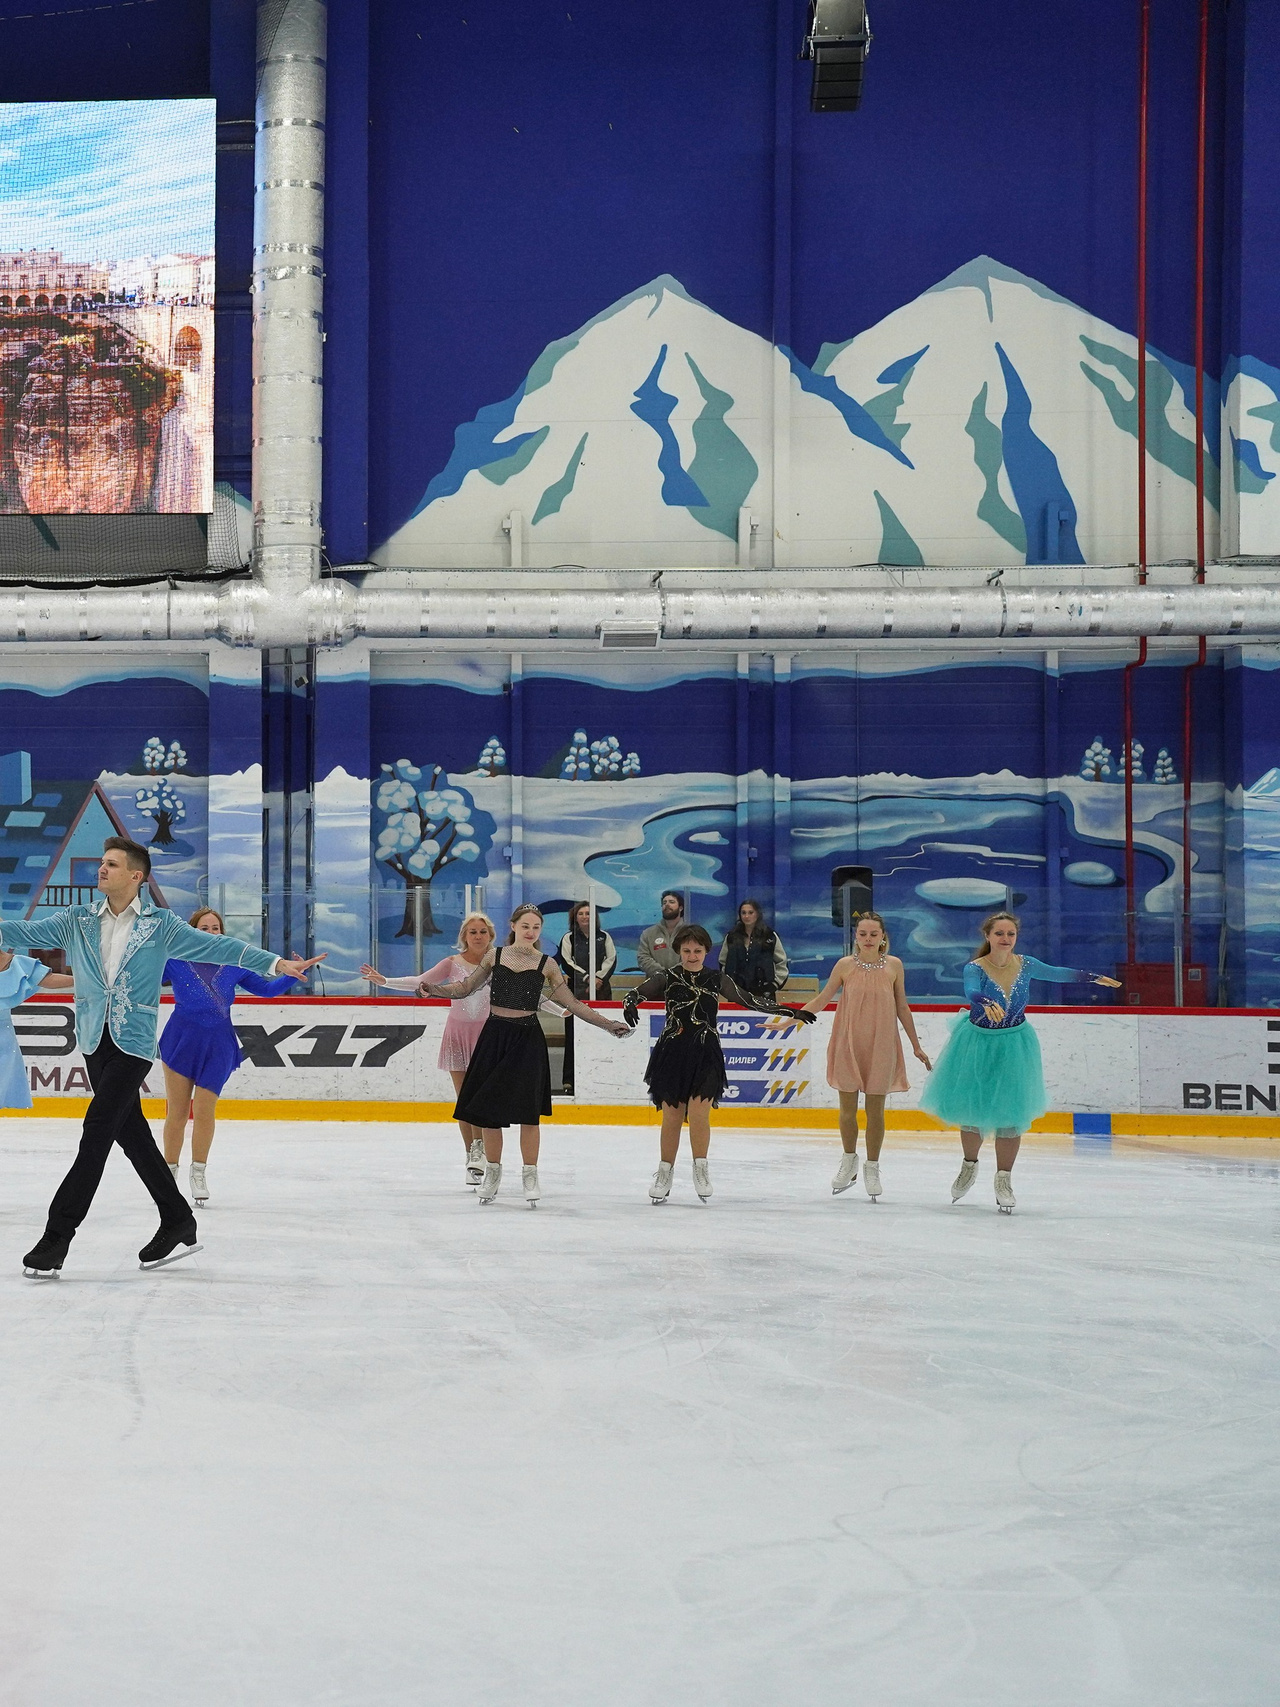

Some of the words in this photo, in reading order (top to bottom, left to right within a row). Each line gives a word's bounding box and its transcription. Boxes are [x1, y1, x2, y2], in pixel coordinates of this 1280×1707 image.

[233, 1025, 427, 1067] X17
[728, 1056, 757, 1065] ДИЛЕР
[1182, 1082, 1280, 1112] BEN
